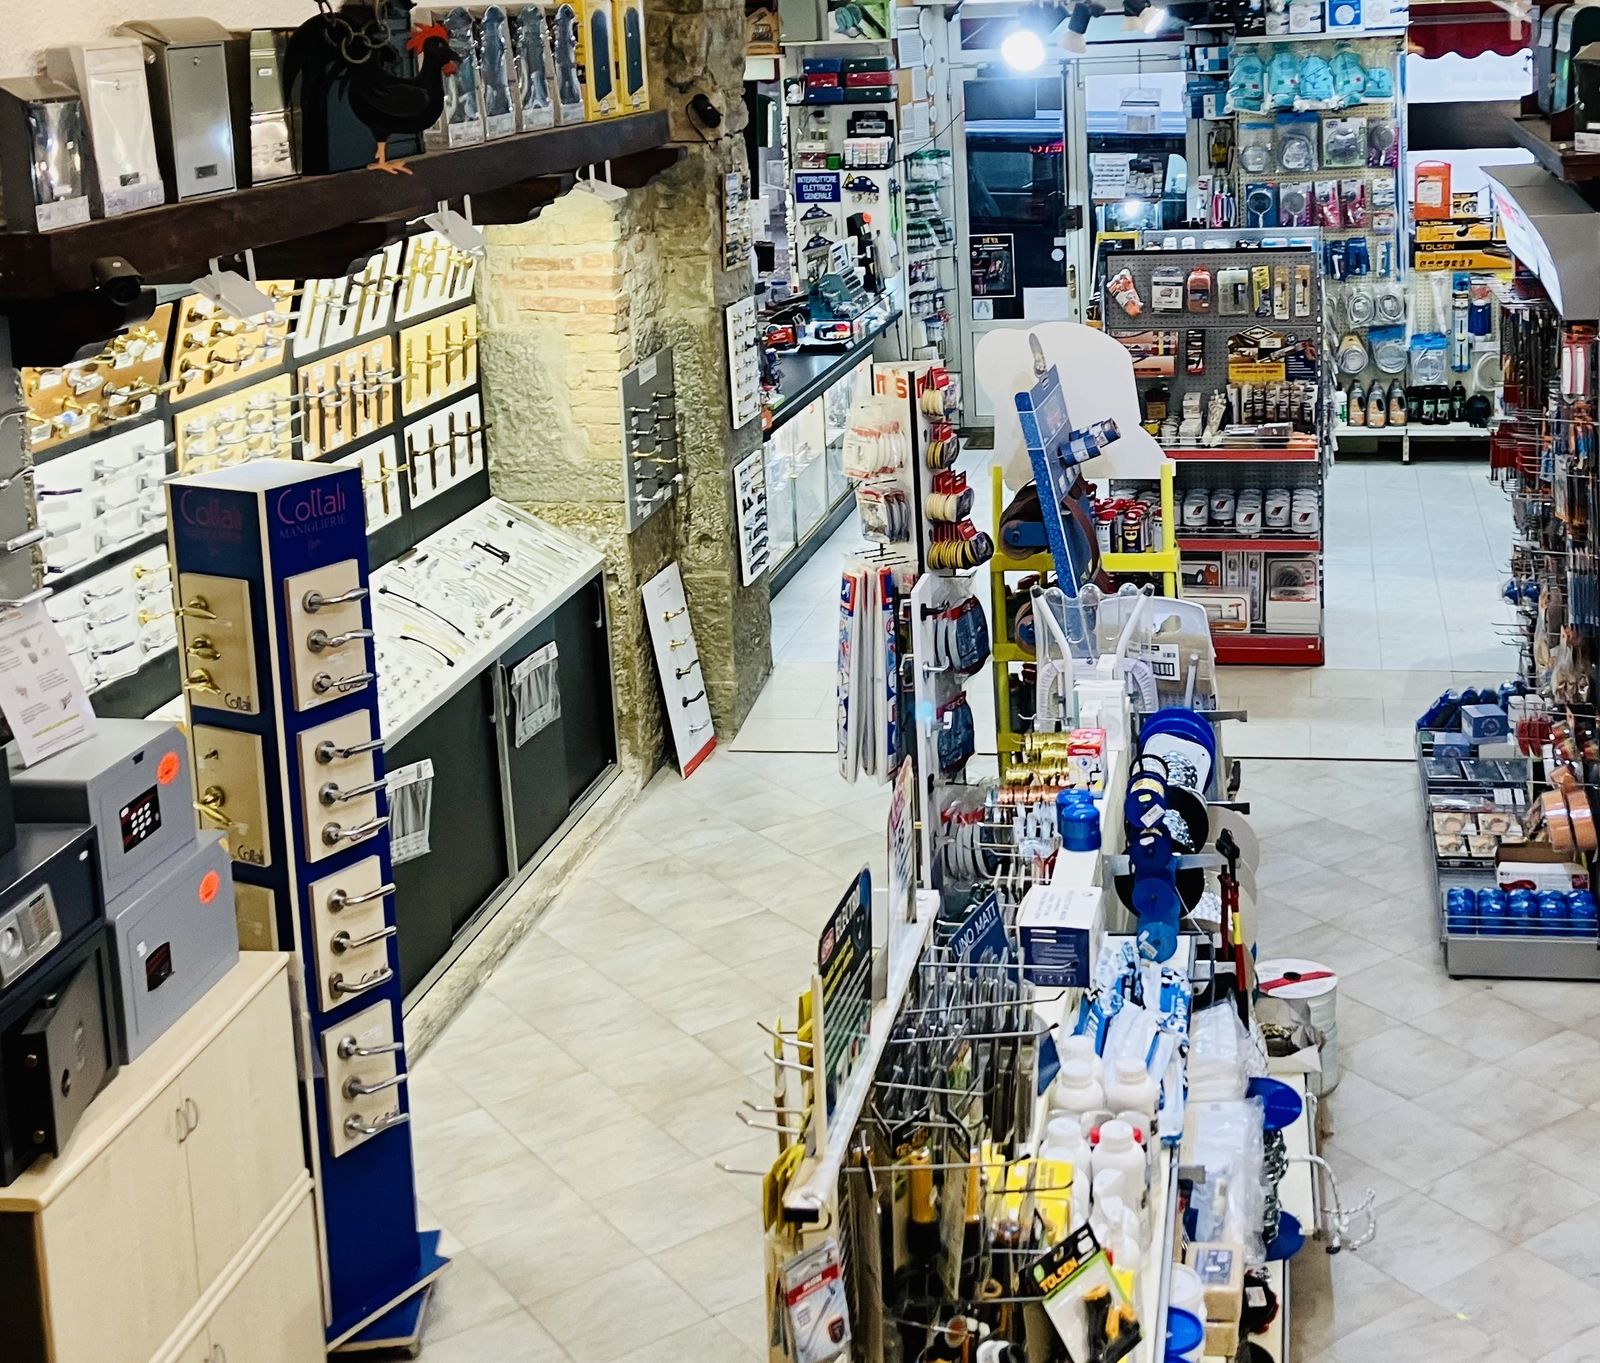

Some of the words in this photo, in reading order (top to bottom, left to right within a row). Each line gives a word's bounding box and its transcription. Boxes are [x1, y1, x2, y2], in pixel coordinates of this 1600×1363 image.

[797, 175, 838, 184] INTERRUTTORE
[802, 184, 833, 192] ELETTRICO
[803, 192, 833, 200] GENERALE
[1420, 243, 1455, 251] TOLSEN
[279, 513, 346, 540] MANIGLIERIE
[974, 900, 997, 936] MATT
[1039, 1256, 1079, 1293] TOLSEN
